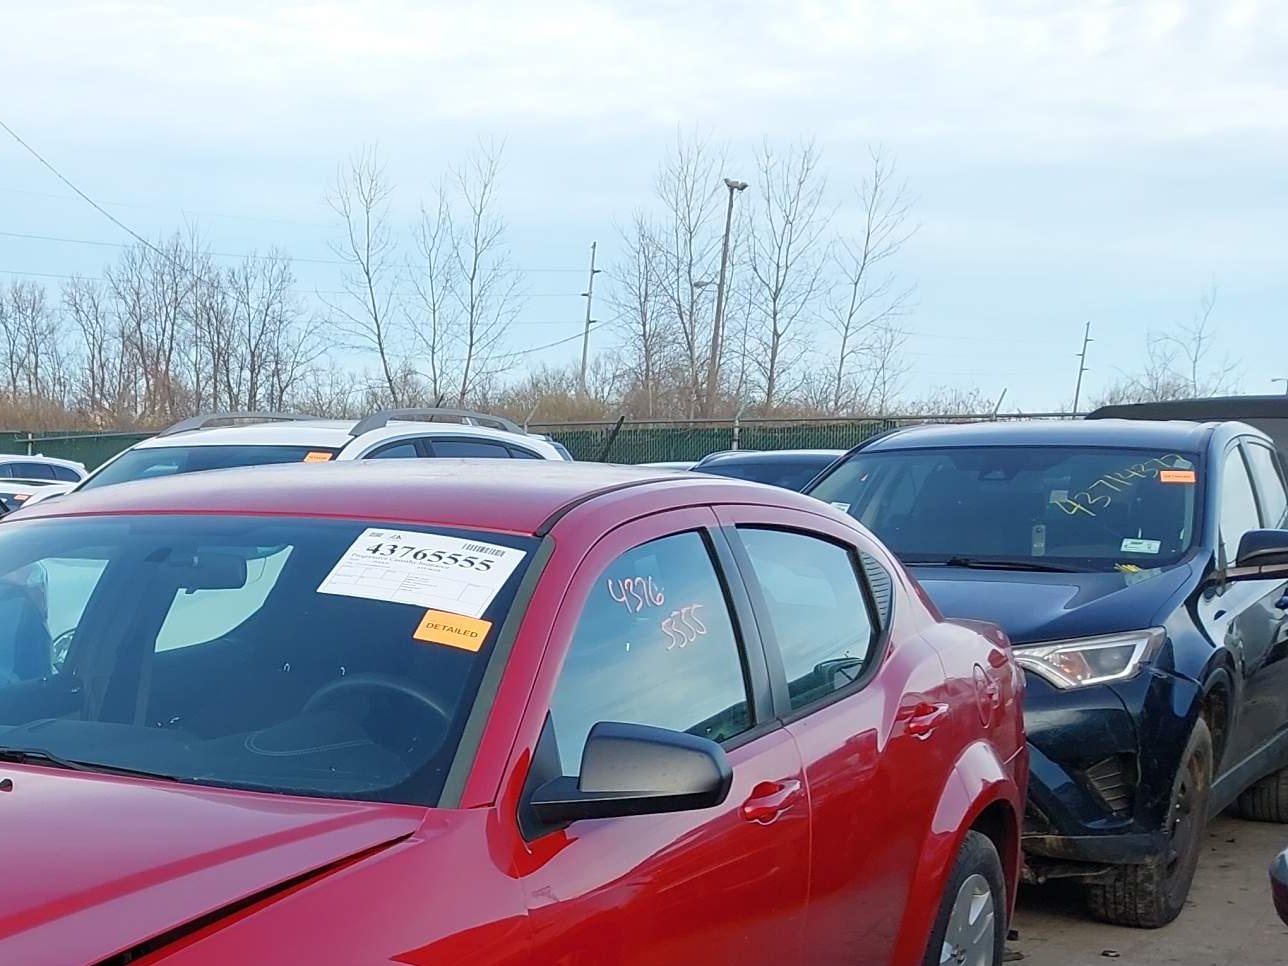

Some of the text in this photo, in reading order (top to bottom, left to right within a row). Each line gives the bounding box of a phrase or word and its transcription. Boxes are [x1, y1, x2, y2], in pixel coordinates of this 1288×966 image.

[366, 542, 495, 572] 43765555
[608, 576, 665, 613] 4376
[426, 621, 478, 638] DETAILED
[661, 604, 707, 651] 5555
